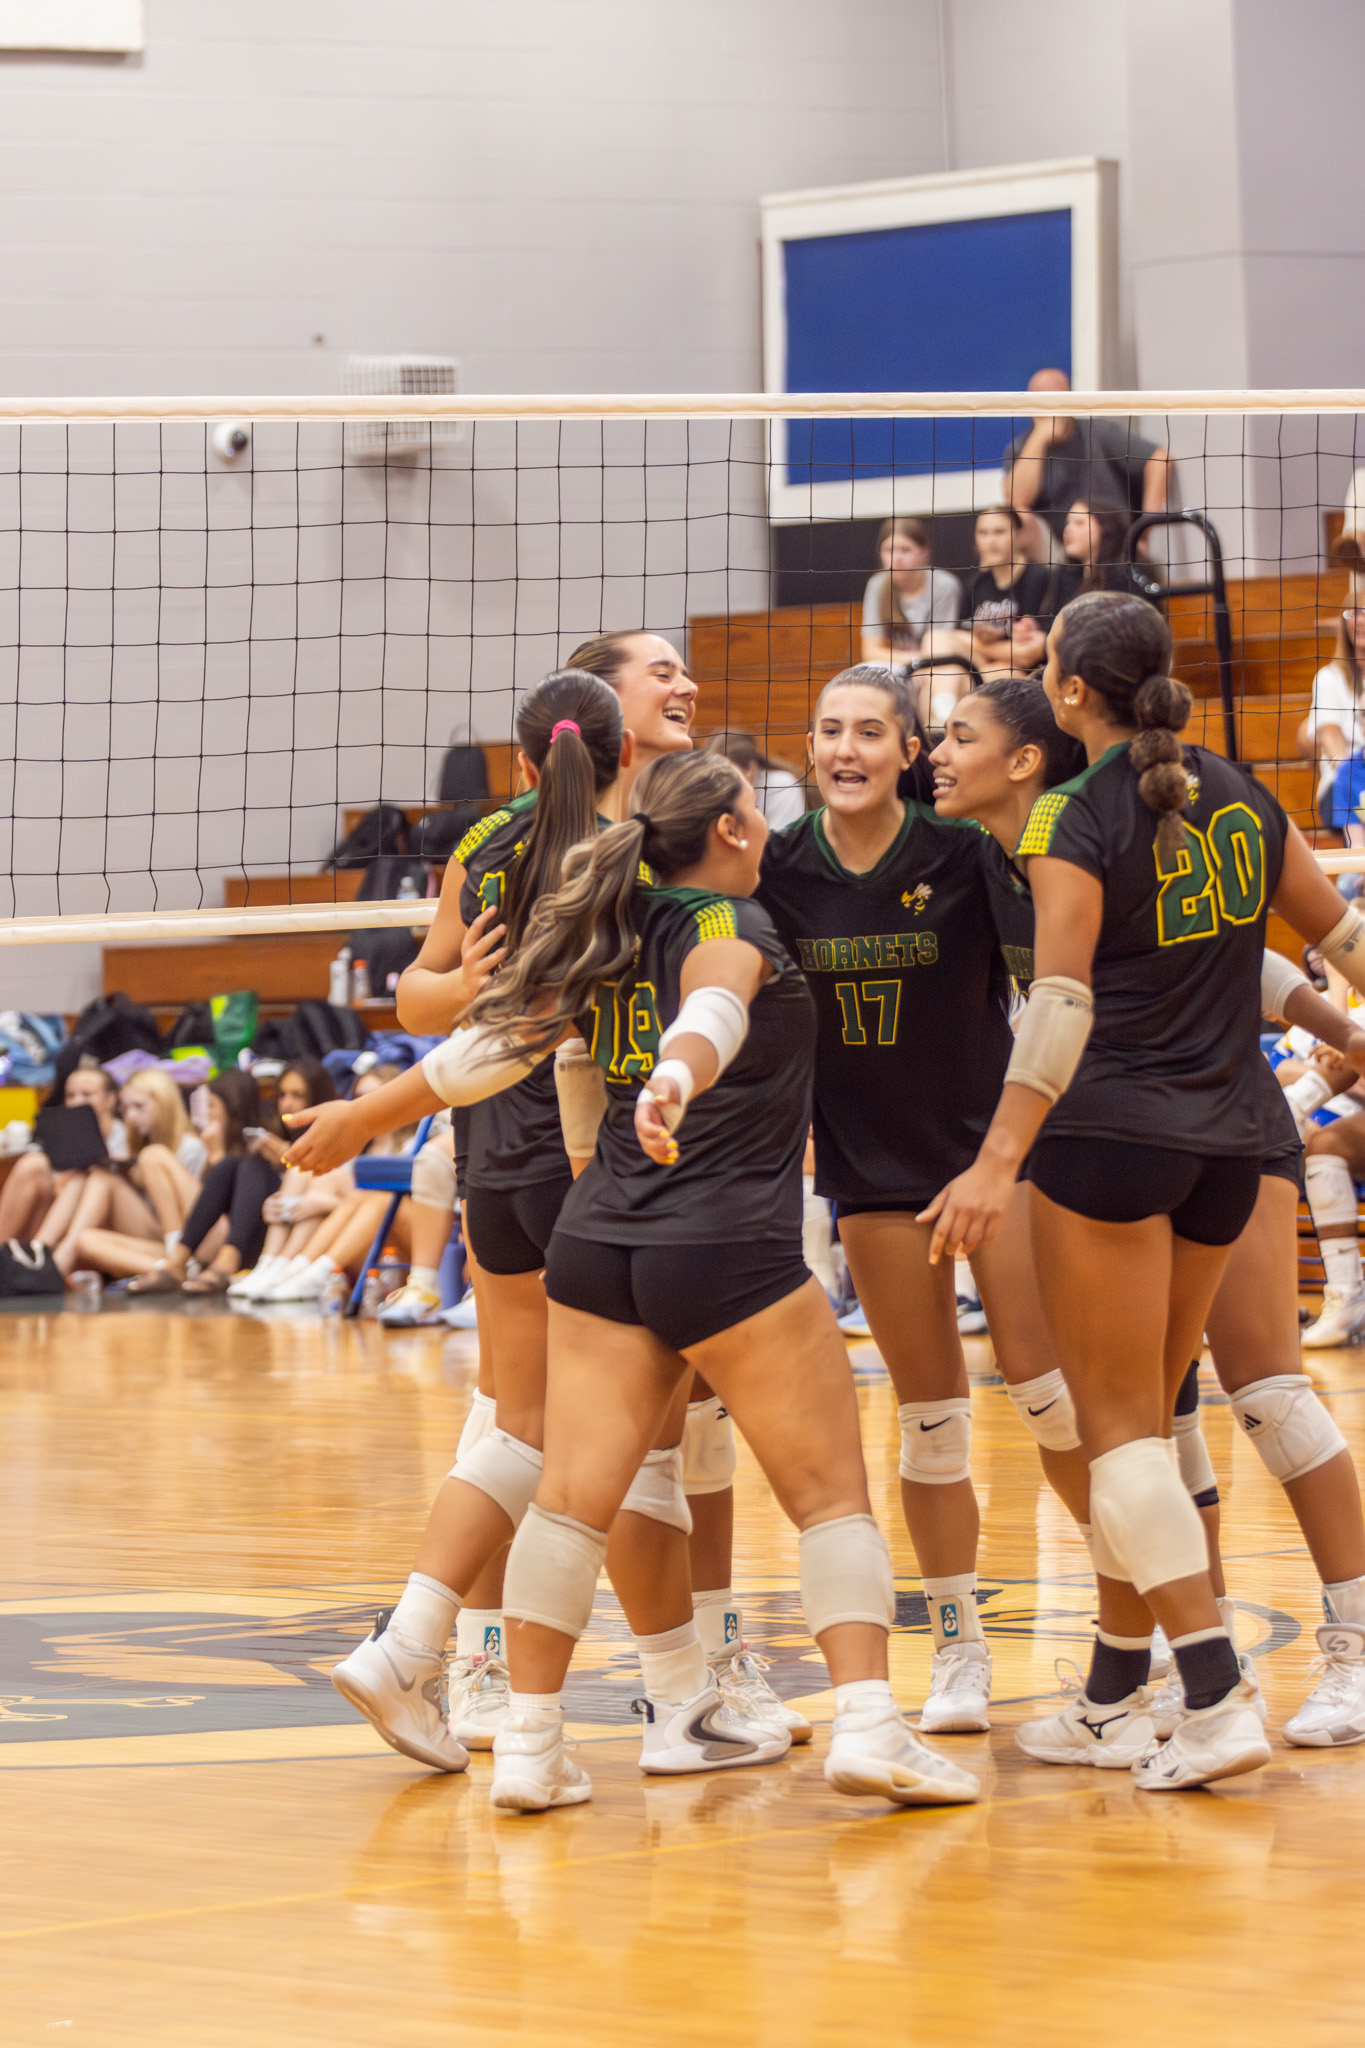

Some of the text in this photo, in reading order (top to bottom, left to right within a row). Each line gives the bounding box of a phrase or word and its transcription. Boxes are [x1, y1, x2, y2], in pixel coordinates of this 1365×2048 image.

[1153, 802, 1266, 946] 20
[796, 931, 939, 972] HORNETS
[589, 981, 664, 1084] 19
[835, 979, 902, 1045] 17
